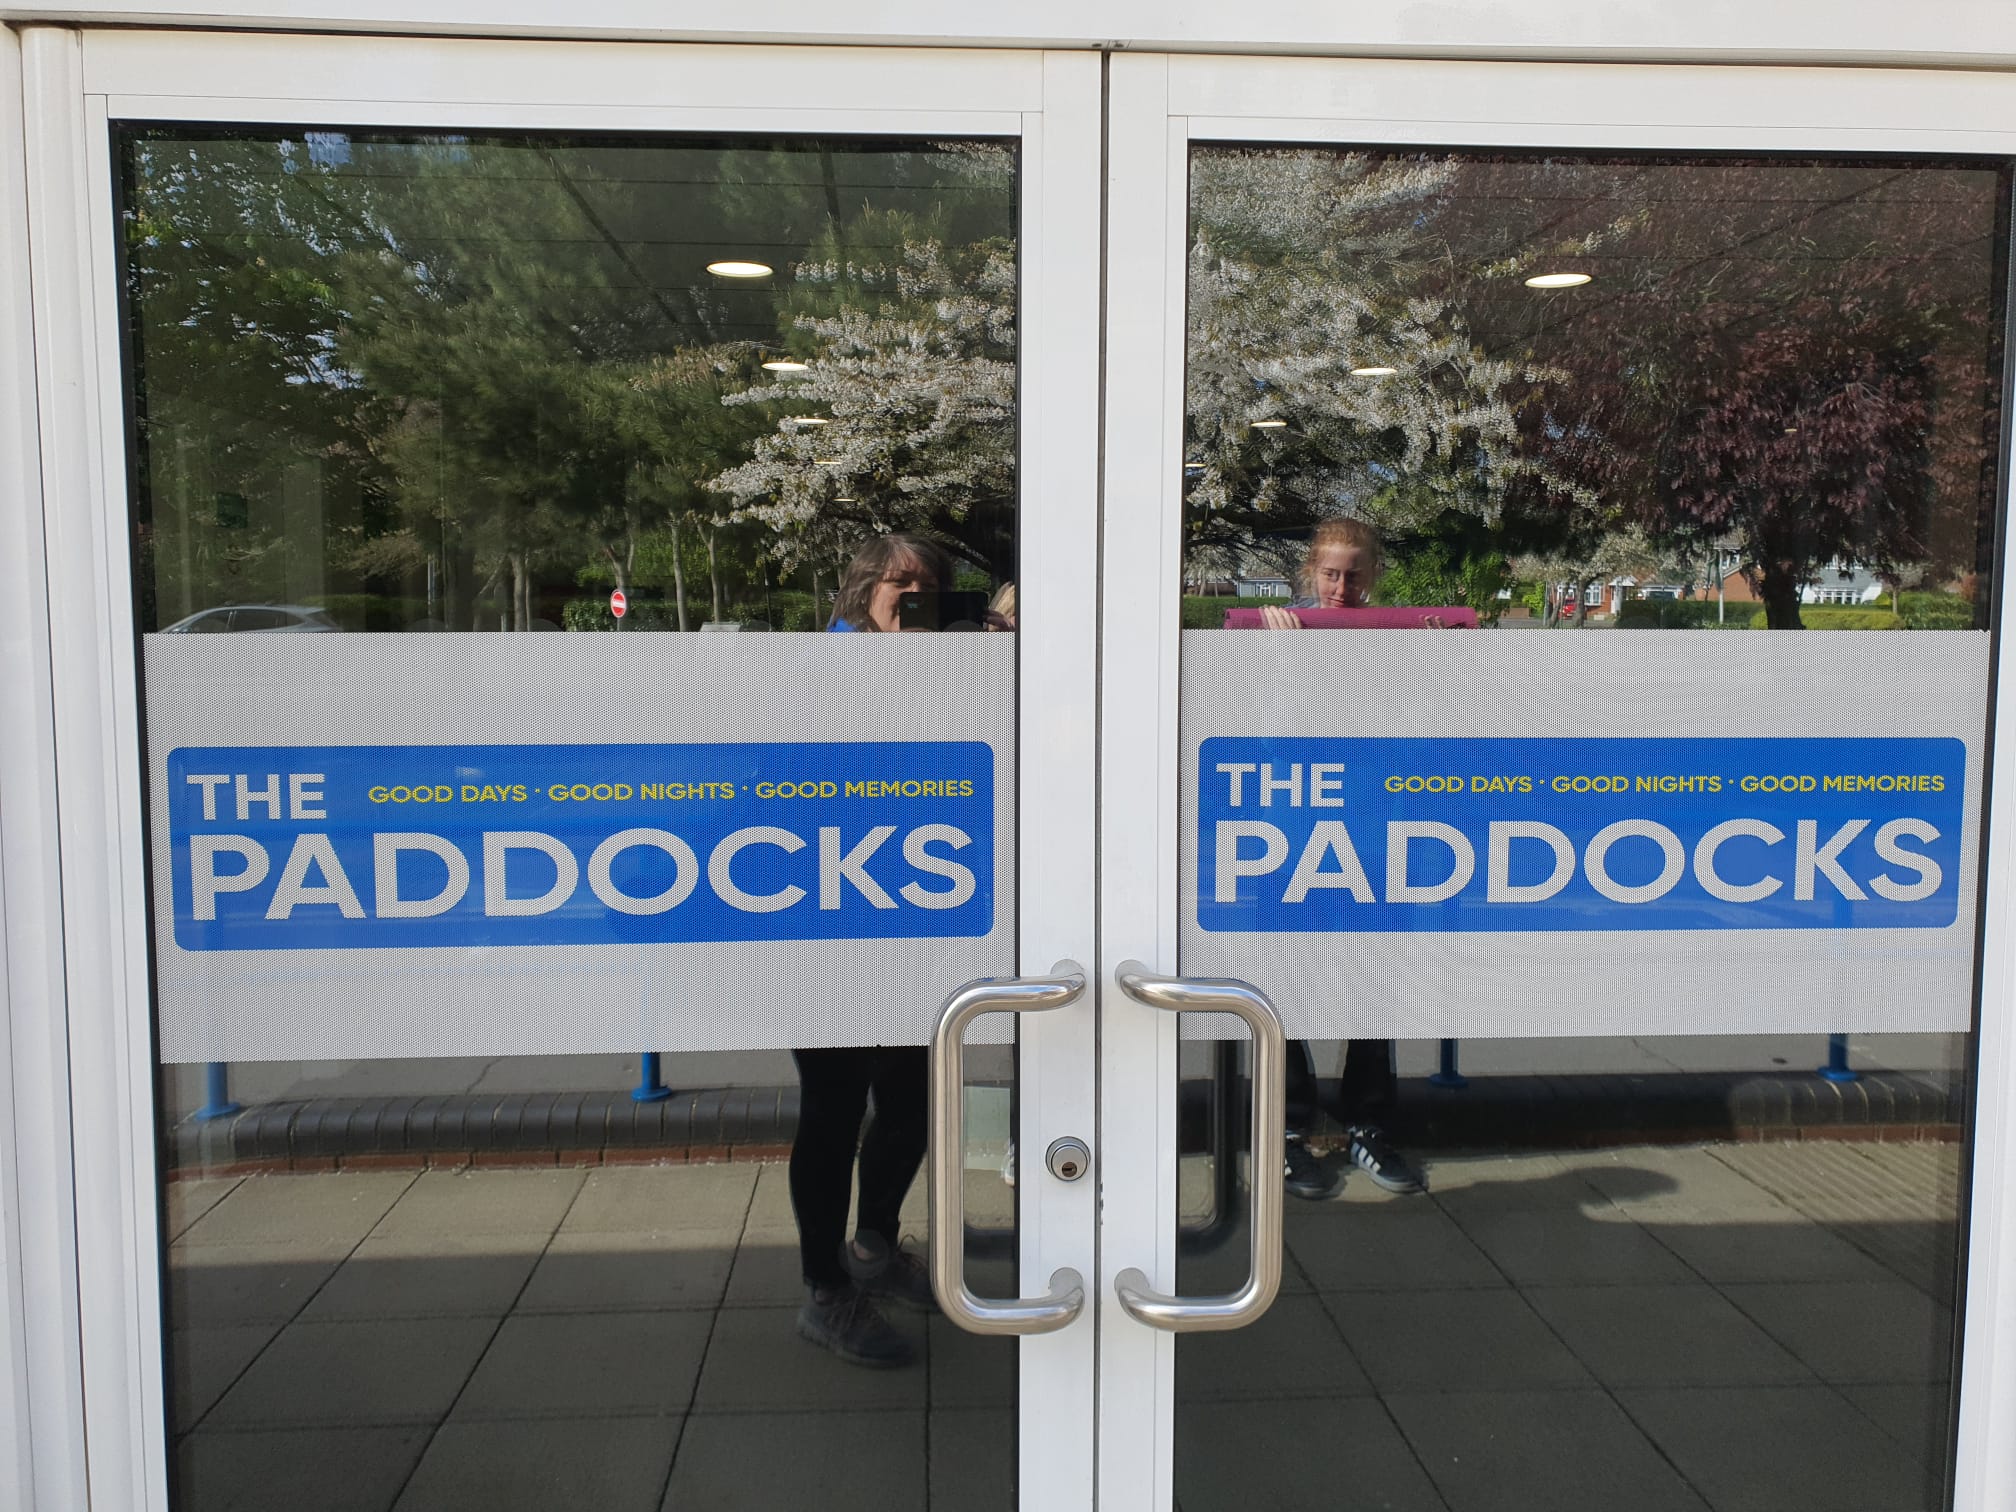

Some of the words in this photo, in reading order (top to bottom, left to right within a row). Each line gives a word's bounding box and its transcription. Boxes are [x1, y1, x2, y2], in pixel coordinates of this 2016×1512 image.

[187, 774, 327, 820] THE
[368, 784, 453, 803] GOOD
[461, 784, 528, 802] DAYS
[548, 783, 633, 801] GOOD
[641, 783, 735, 800] NIGHTS
[755, 781, 838, 798] GOOD
[845, 780, 974, 797] MEMORIES
[1216, 763, 1345, 807] THE
[1384, 775, 1465, 793] GOOD
[1471, 775, 1533, 793] DAYS
[1551, 775, 1629, 793] GOOD
[1636, 775, 1722, 793] NIGHTS
[1740, 775, 1817, 792] GOOD
[1822, 775, 1945, 792] MEMORIES
[190, 825, 976, 921] PADDOCKS
[1215, 819, 1943, 904] PADDOCKS
